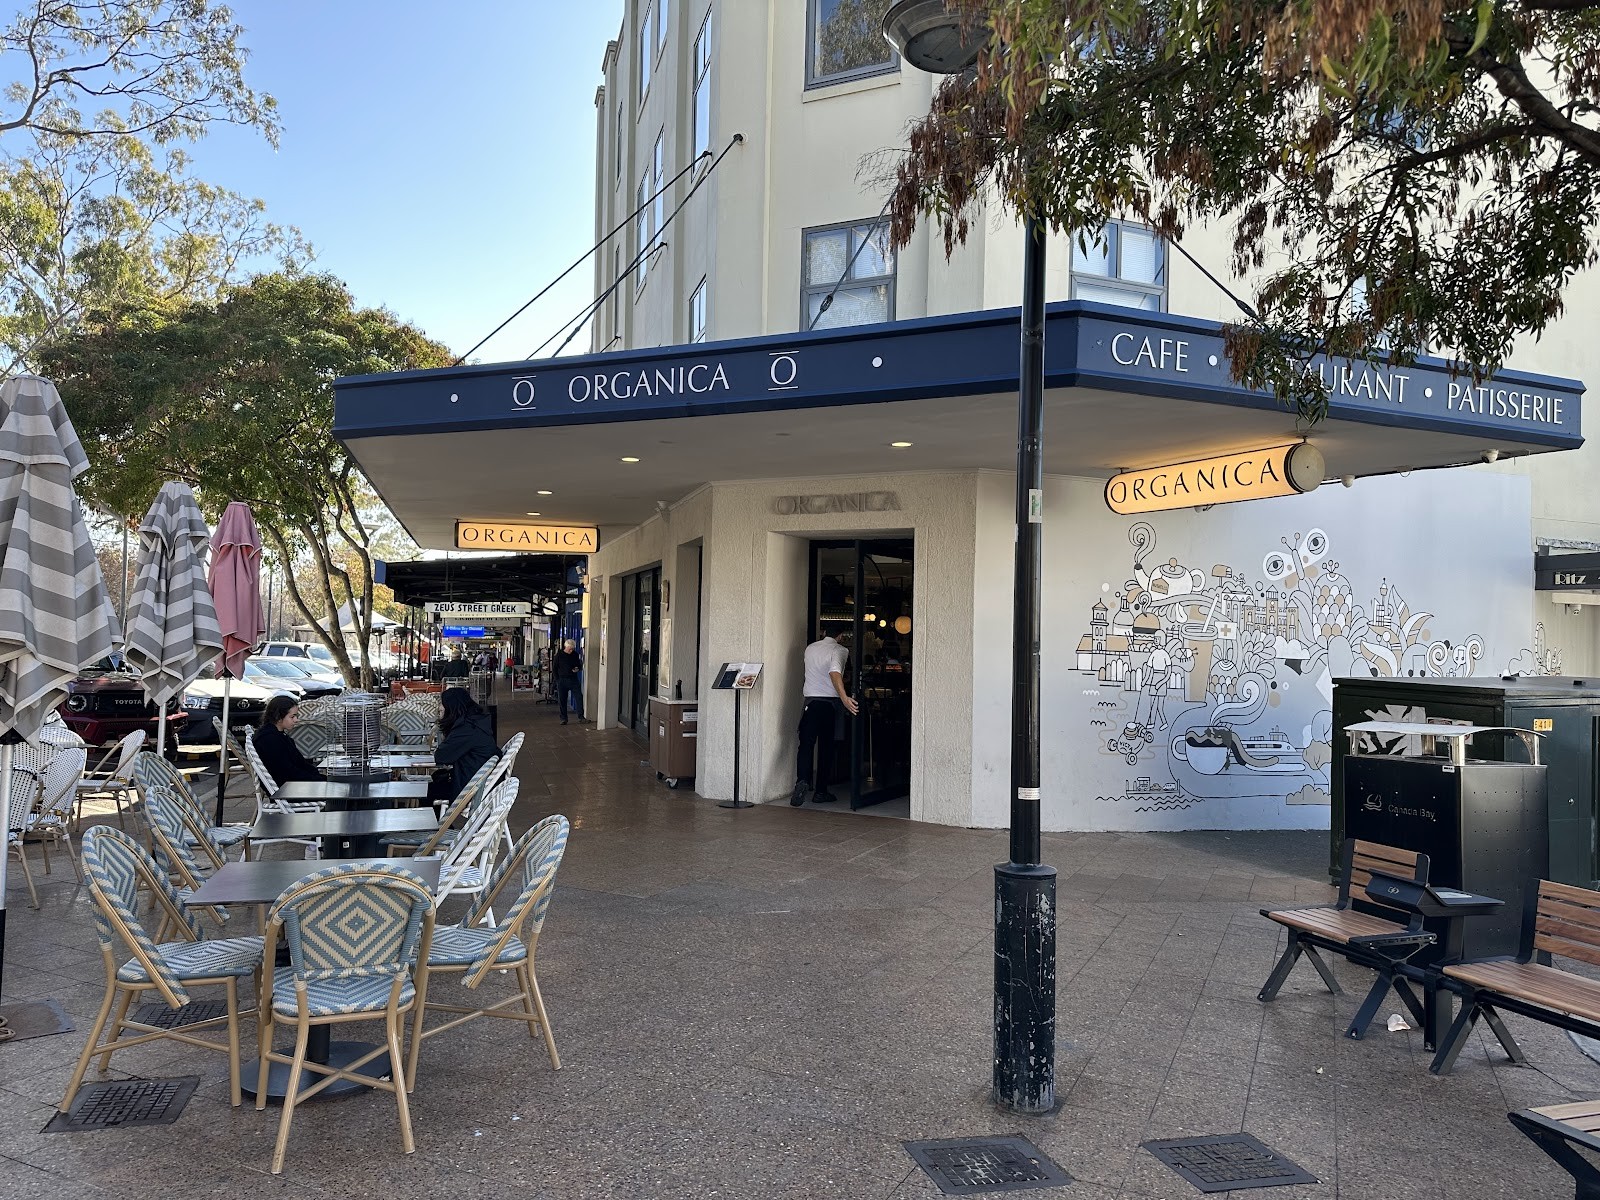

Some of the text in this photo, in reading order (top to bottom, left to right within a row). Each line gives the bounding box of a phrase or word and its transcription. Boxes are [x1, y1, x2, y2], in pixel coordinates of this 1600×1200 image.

[568, 363, 731, 404] ORGANICA
[1112, 332, 1563, 425] CAFE TAURANT PATISSERIE
[1110, 458, 1279, 504] ORGANICA
[775, 491, 902, 515] ORGANICA
[462, 527, 592, 546] ORGANICA
[1555, 571, 1587, 585] Ritz
[434, 603, 516, 613] ZEUS STREET GREEK
[1388, 804, 1436, 820] Canada Bay
